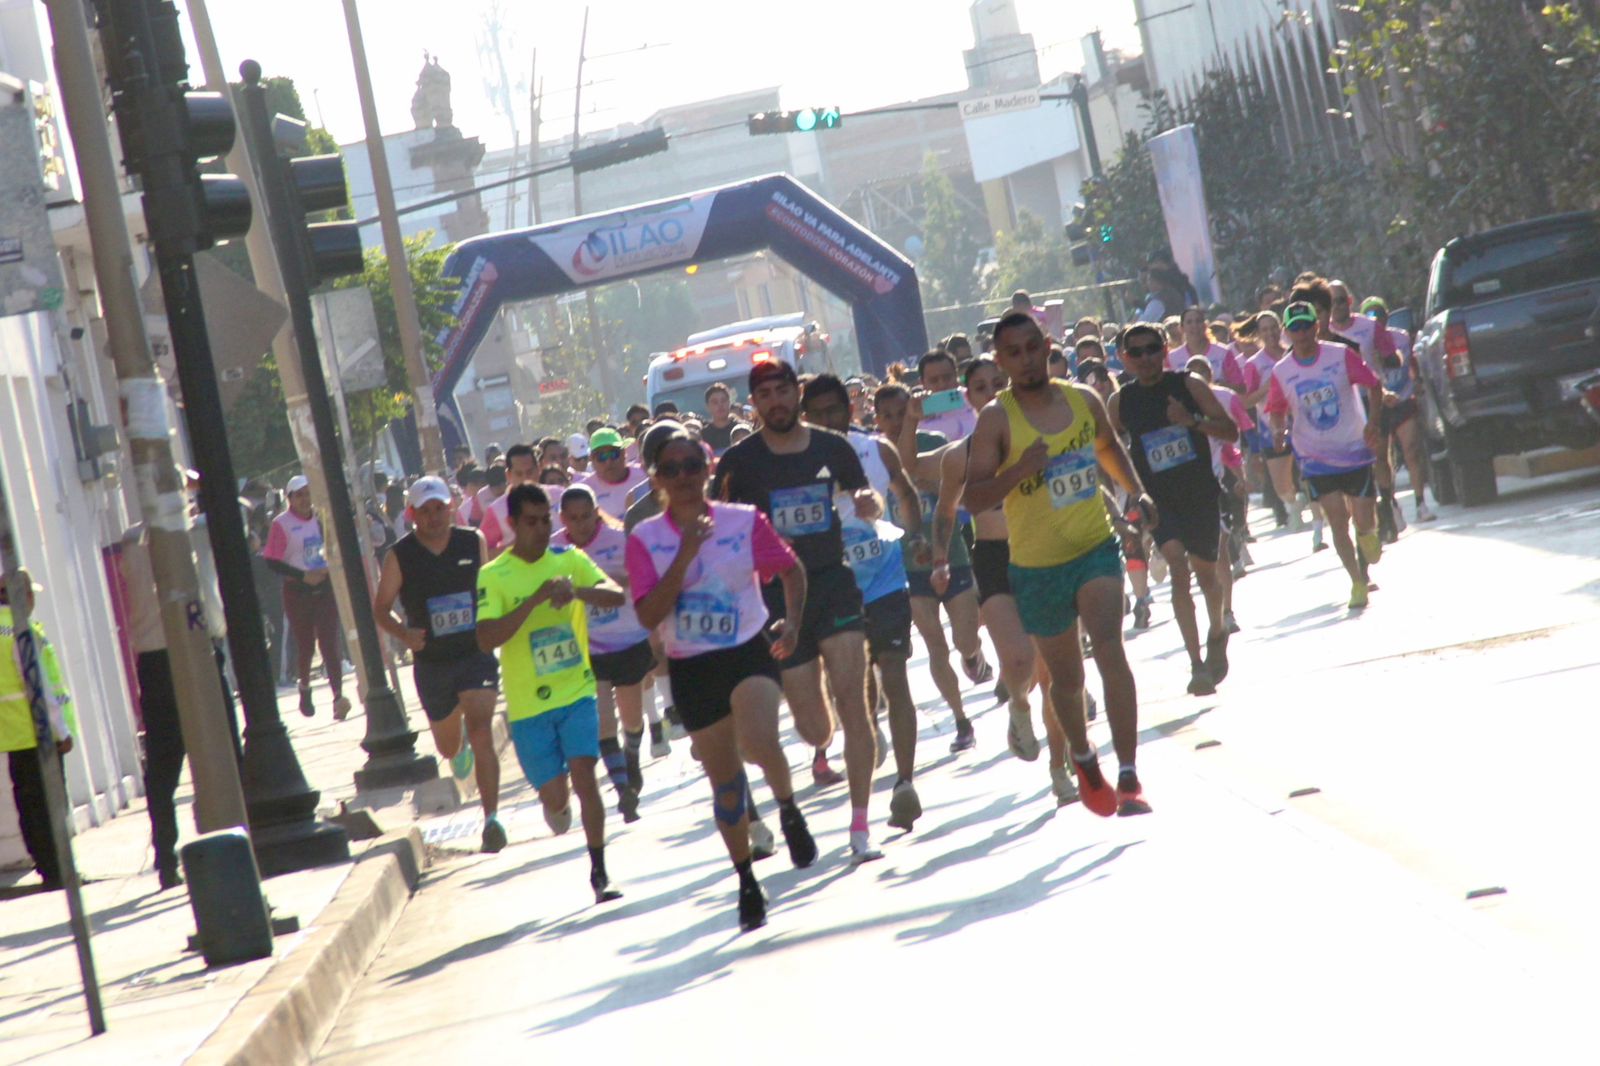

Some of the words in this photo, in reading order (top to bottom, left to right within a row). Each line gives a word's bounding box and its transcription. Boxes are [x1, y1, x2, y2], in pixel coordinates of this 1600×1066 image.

[963, 100, 991, 116] Calle
[994, 94, 1036, 111] Madero
[803, 211, 819, 228] VA
[817, 222, 847, 248] PARA
[845, 242, 902, 285] ADELANTE
[1151, 439, 1188, 462] 086
[1052, 468, 1097, 497] 096
[777, 504, 824, 527] 165
[434, 610, 470, 628] 088
[682, 613, 733, 634] 106
[537, 640, 579, 664] 140
